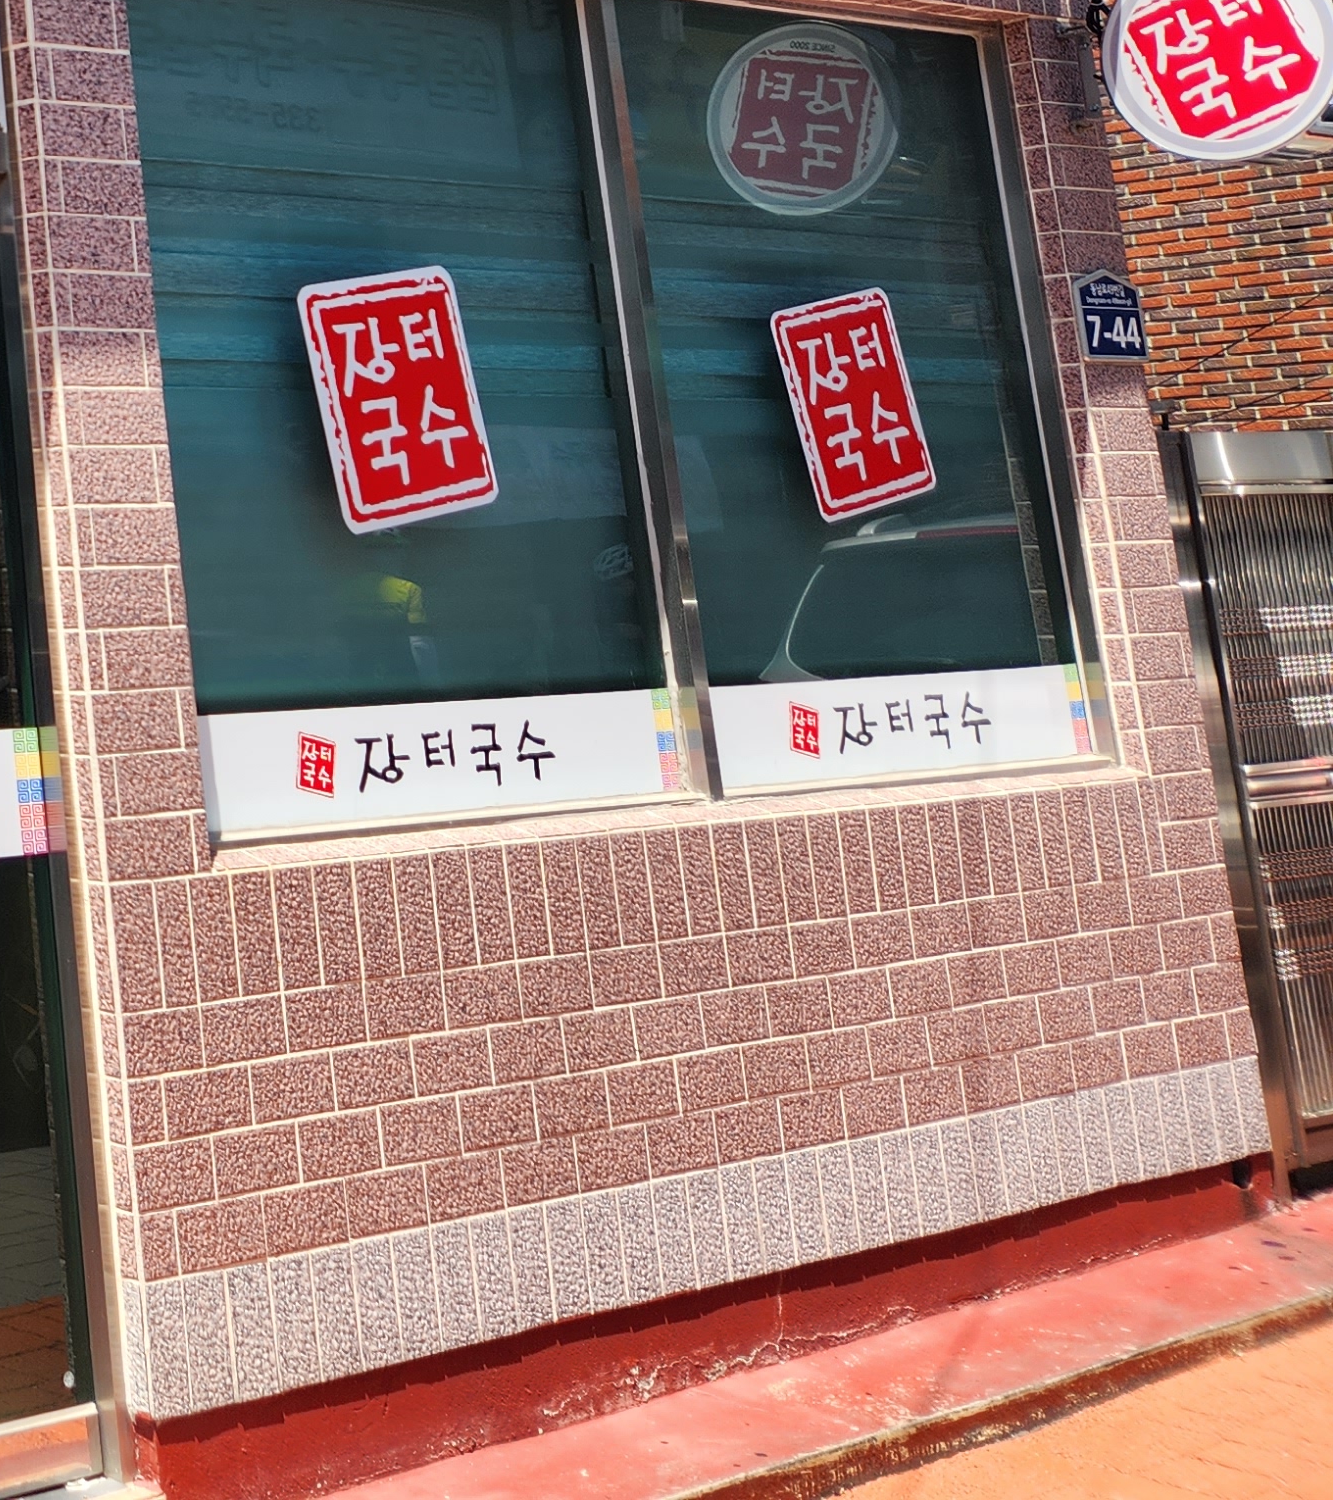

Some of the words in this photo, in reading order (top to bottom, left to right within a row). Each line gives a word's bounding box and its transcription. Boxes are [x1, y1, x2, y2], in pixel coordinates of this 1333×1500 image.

[1175, 35, 1301, 119] 국수
[331, 308, 445, 398] 장터
[796, 322, 886, 406] 장터
[1086, 314, 1142, 349] 7-44
[360, 383, 470, 486] 국수
[823, 390, 911, 482] 국수
[301, 740, 332, 761] 장터
[792, 708, 817, 728] 장터
[793, 727, 818, 751] 국수
[832, 690, 992, 755] 장터국수
[302, 762, 332, 789] 국수
[353, 719, 556, 794] 장터국수
